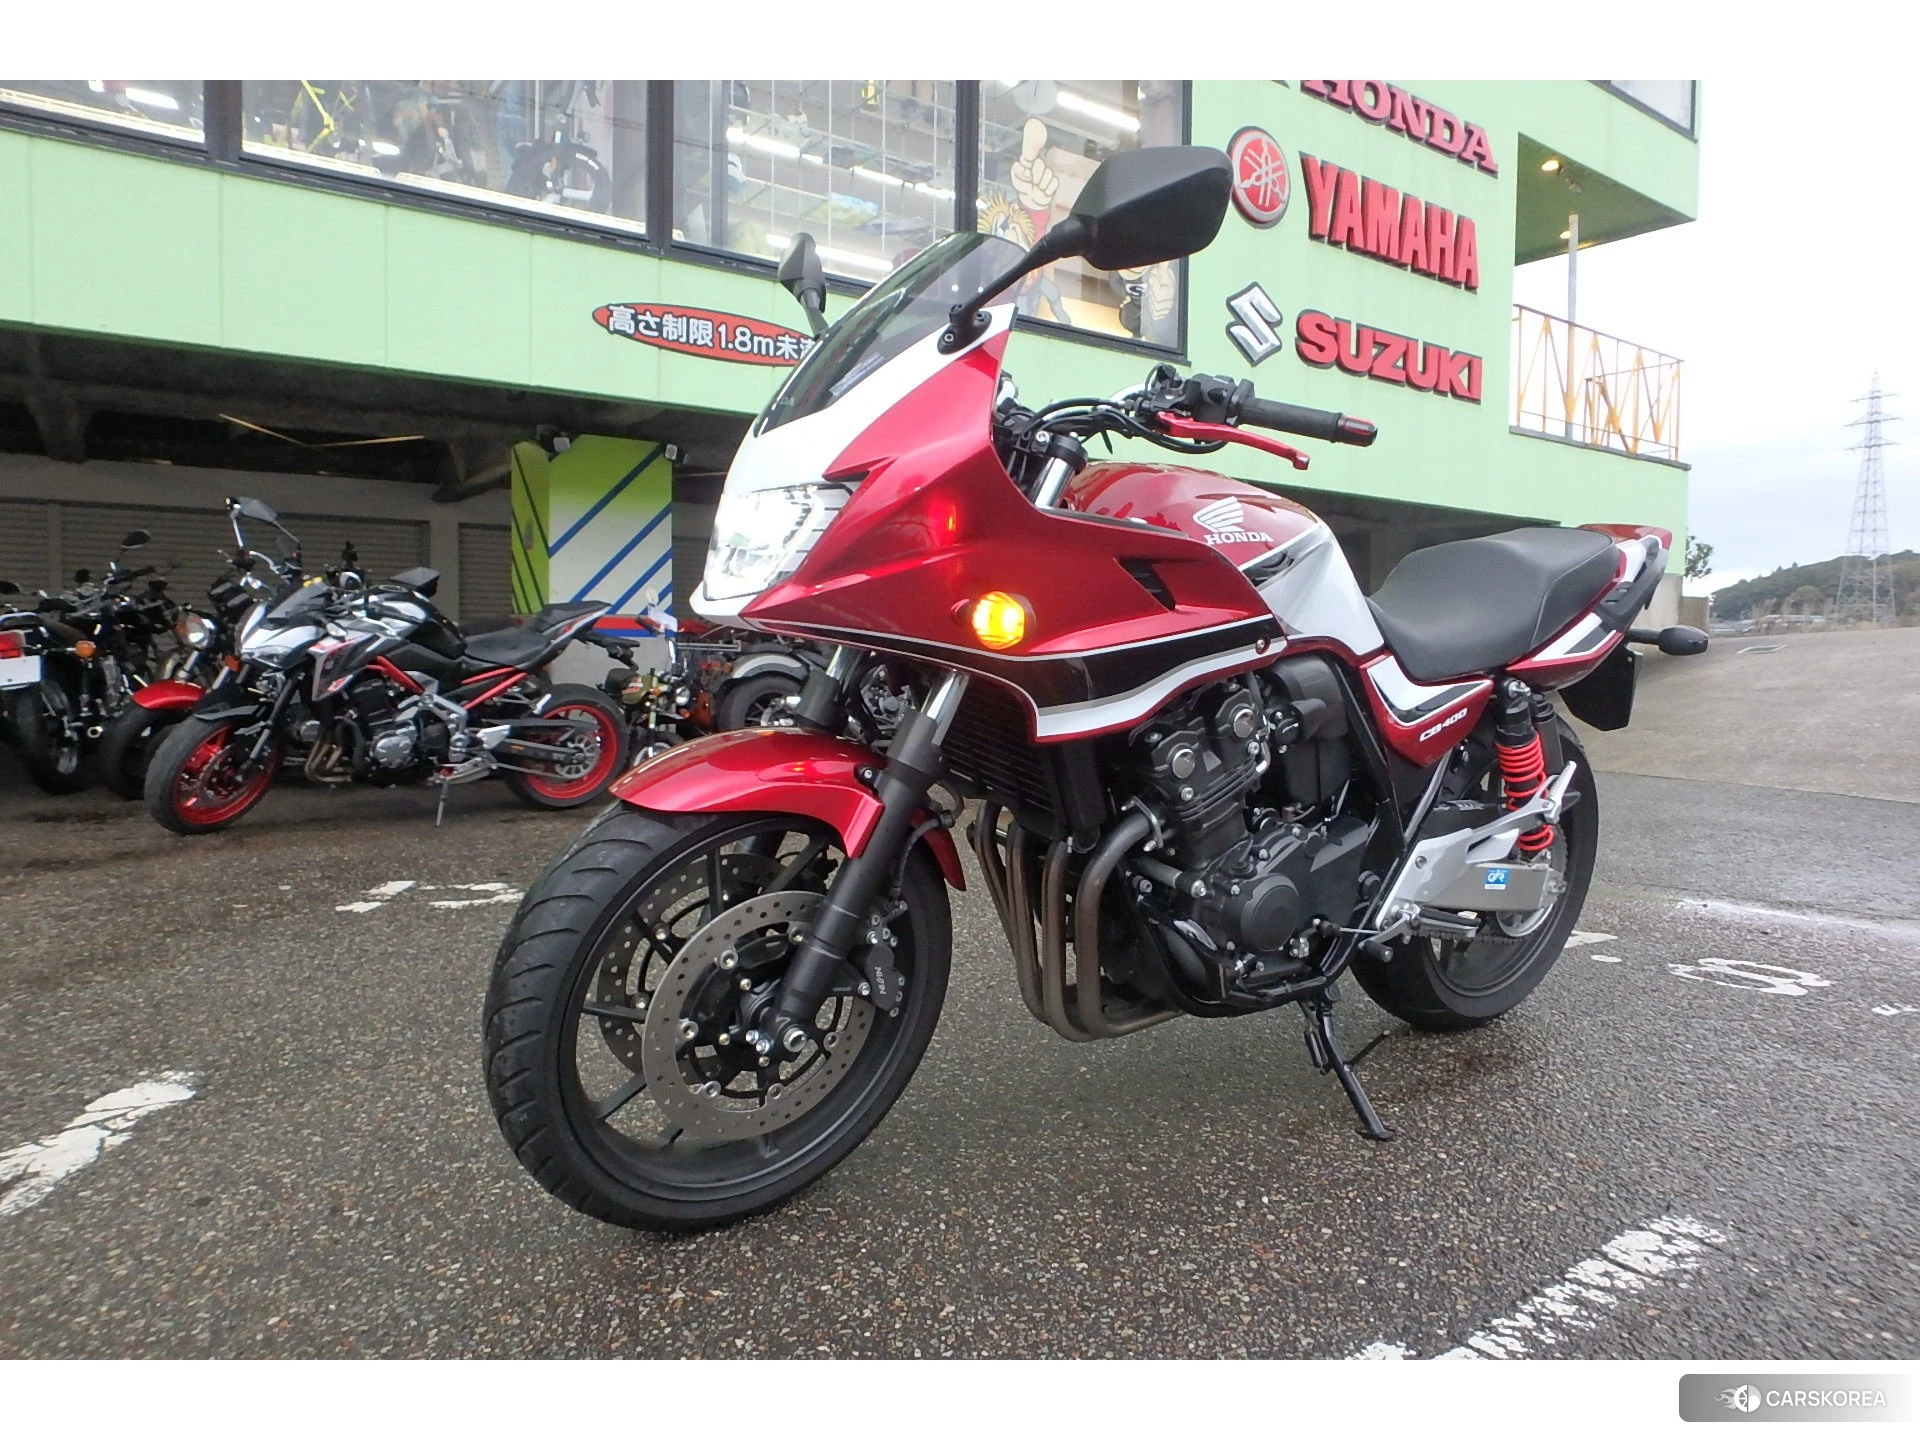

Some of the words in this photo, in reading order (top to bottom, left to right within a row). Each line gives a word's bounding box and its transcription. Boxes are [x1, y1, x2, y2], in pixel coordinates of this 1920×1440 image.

[1301, 153, 1479, 290] YAMAHA
[1297, 310, 1483, 402] SUZUKI
[1204, 531, 1274, 545] HONDA
